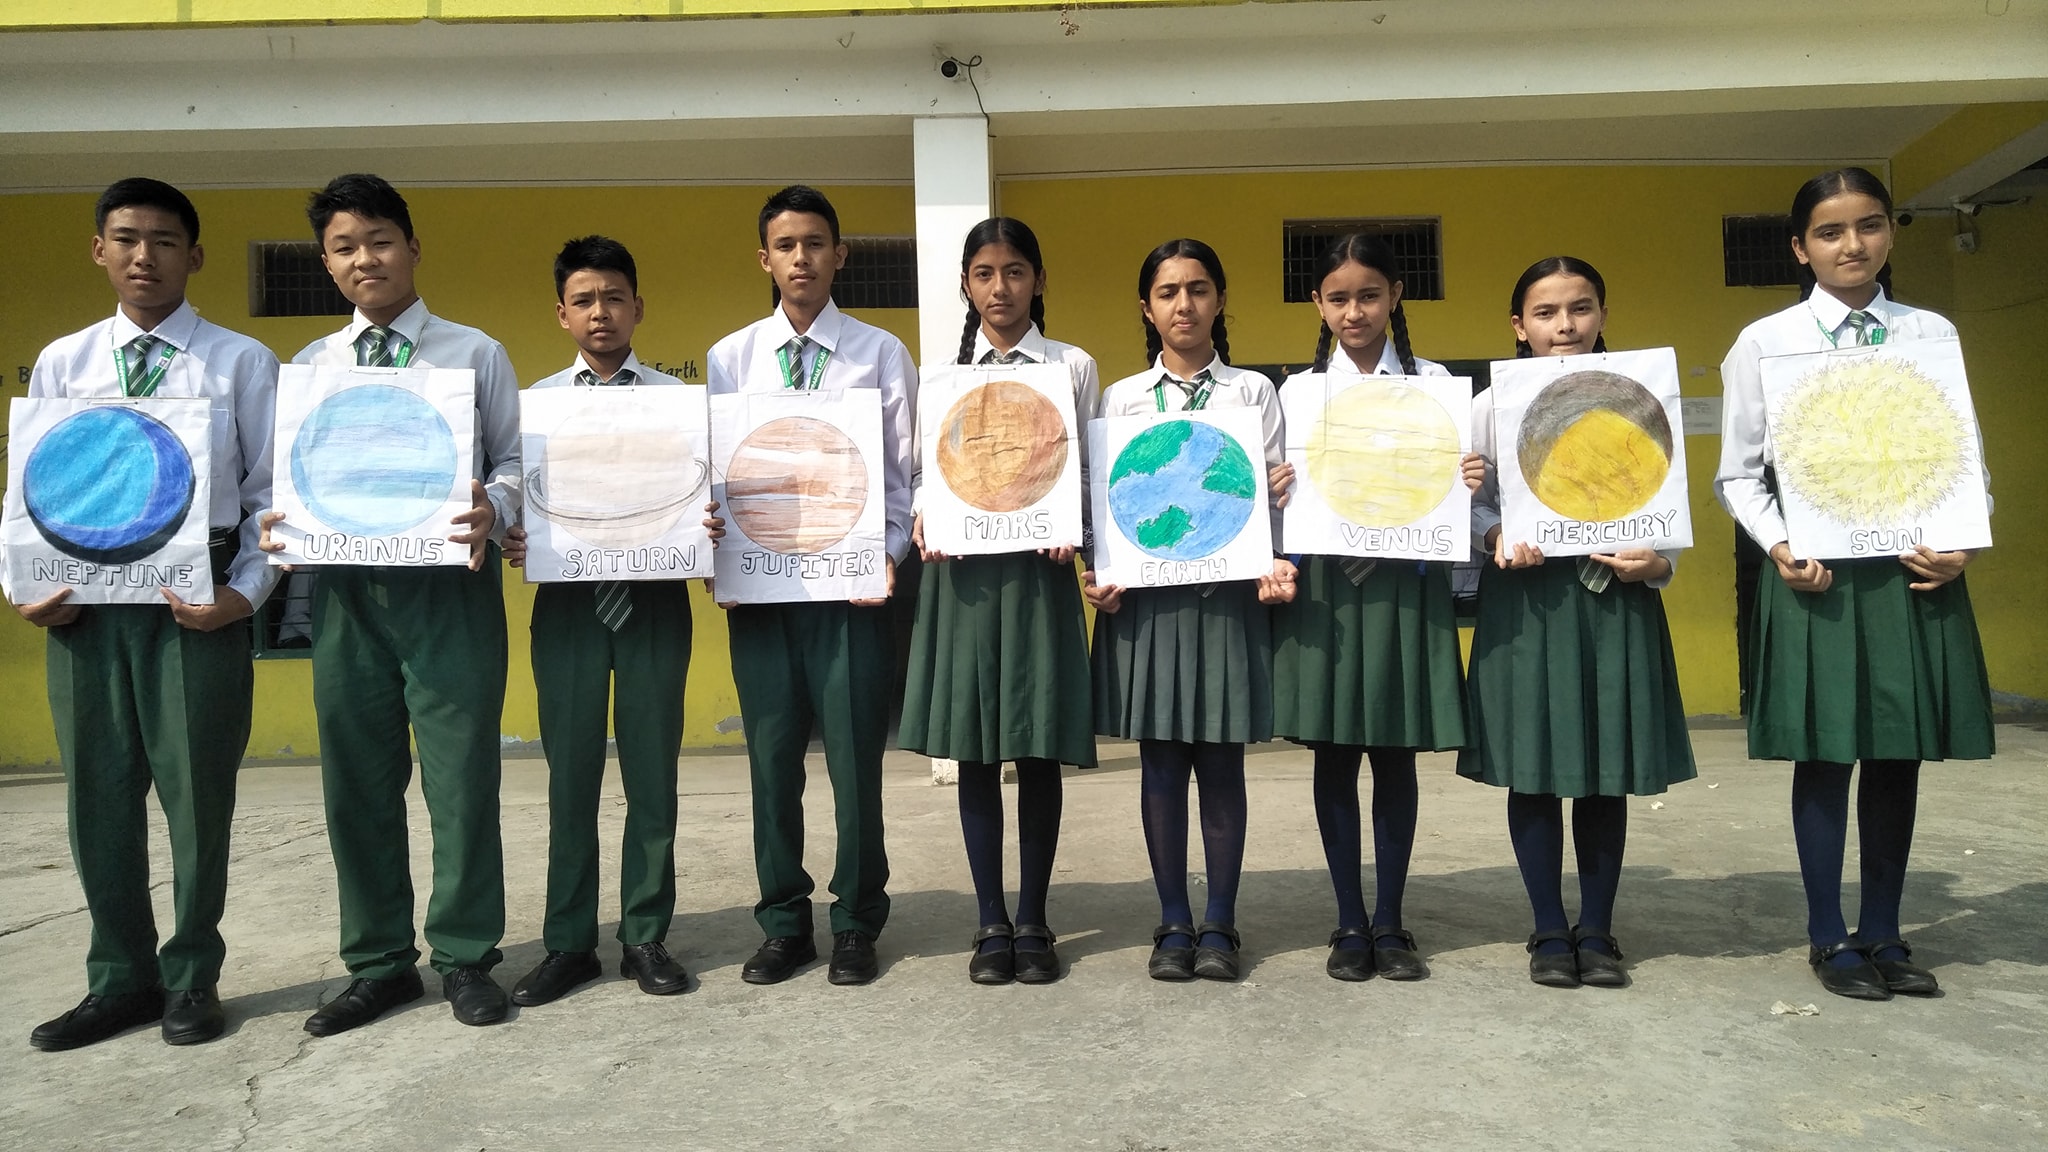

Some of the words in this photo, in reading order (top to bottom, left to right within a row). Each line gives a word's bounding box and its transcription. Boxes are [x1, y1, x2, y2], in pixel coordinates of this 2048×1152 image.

[965, 509, 1053, 540] MARS
[1340, 523, 1454, 556] VENUS
[1537, 509, 1677, 545] MERCURY
[303, 533, 444, 565] URANUS
[1850, 527, 1922, 555] SUN
[32, 558, 193, 588] NEPTUNE
[562, 545, 695, 578] SATURN
[741, 549, 875, 579] JUPITER
[1141, 558, 1227, 586] EARTH
